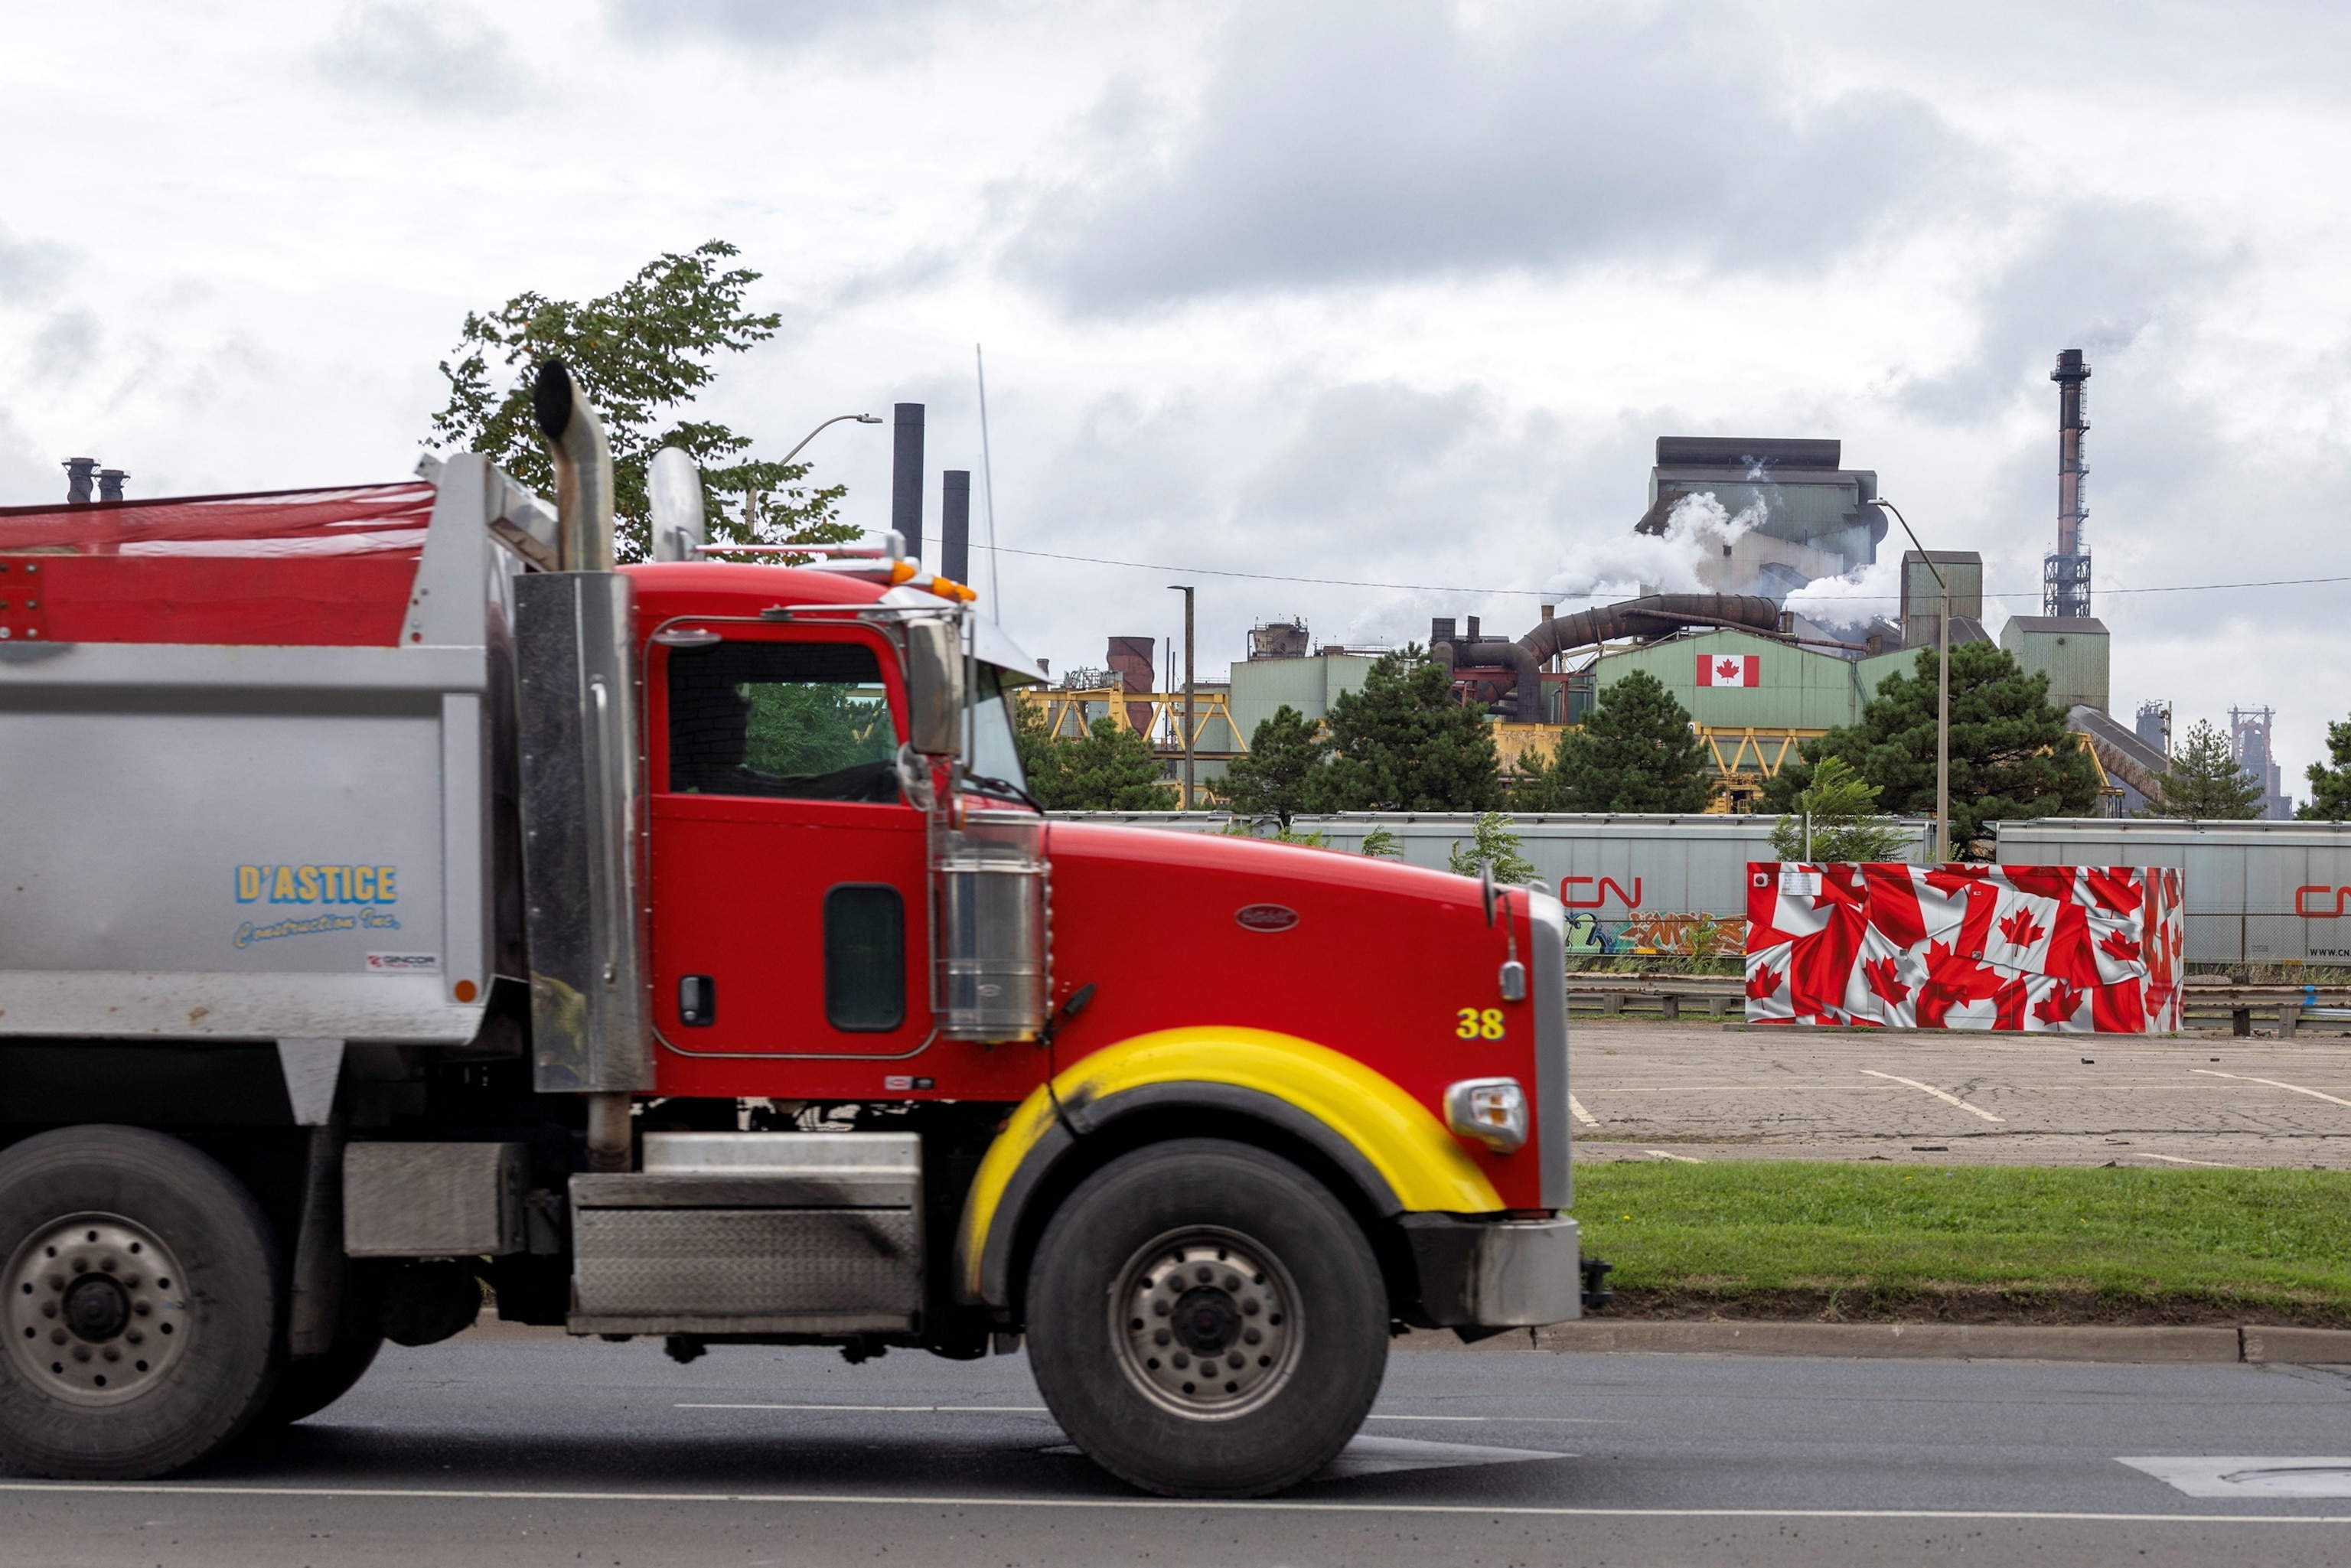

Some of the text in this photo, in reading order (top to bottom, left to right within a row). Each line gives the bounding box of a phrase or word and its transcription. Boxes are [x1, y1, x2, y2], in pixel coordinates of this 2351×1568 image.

[234, 865, 397, 904] D'ASTICE
[1560, 876, 1642, 909] CN
[234, 914, 356, 949] Construction
[1455, 1006, 1506, 1042] 38
